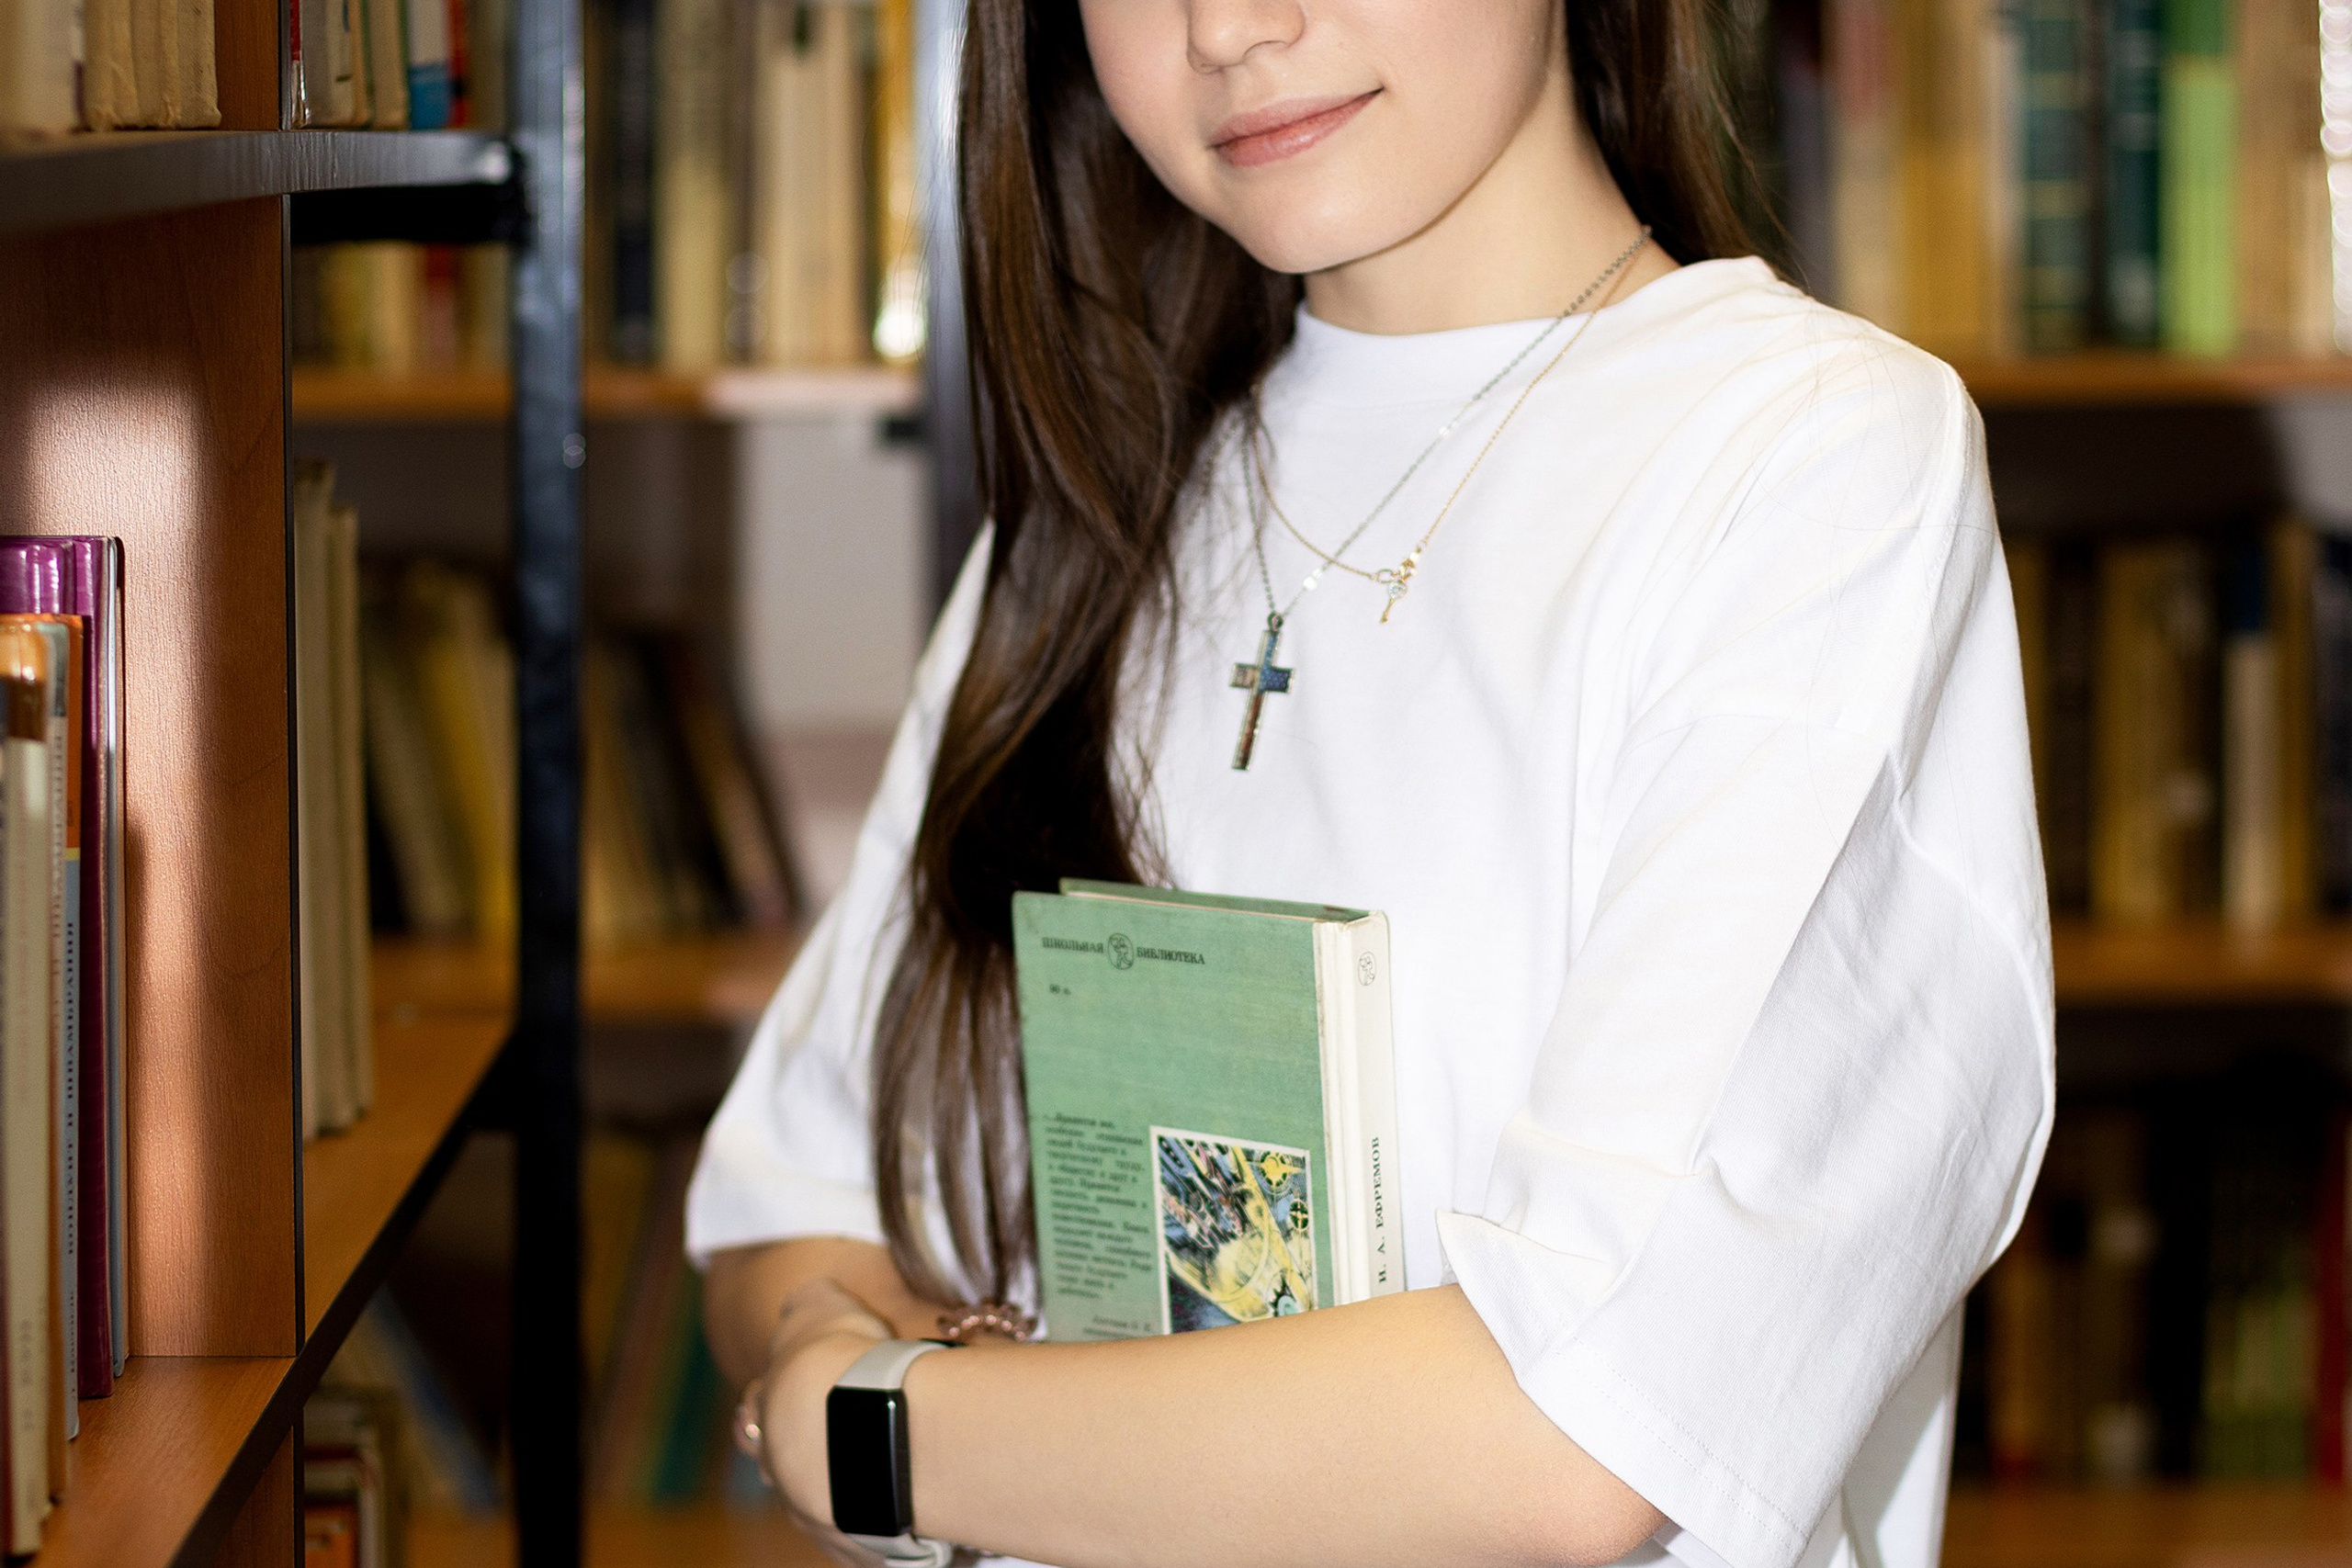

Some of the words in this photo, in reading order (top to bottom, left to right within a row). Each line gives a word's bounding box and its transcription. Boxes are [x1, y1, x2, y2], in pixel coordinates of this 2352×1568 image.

[1042, 937, 1104, 953] ШКОЛЬНАЯ
[1136, 947, 1205, 964] БИБЛИОТЕКА
[1371, 1136, 1385, 1228] ЕФРЕМОВ
[1376, 1236, 1385, 1255] А.
[1378, 1264, 1387, 1283] И.
